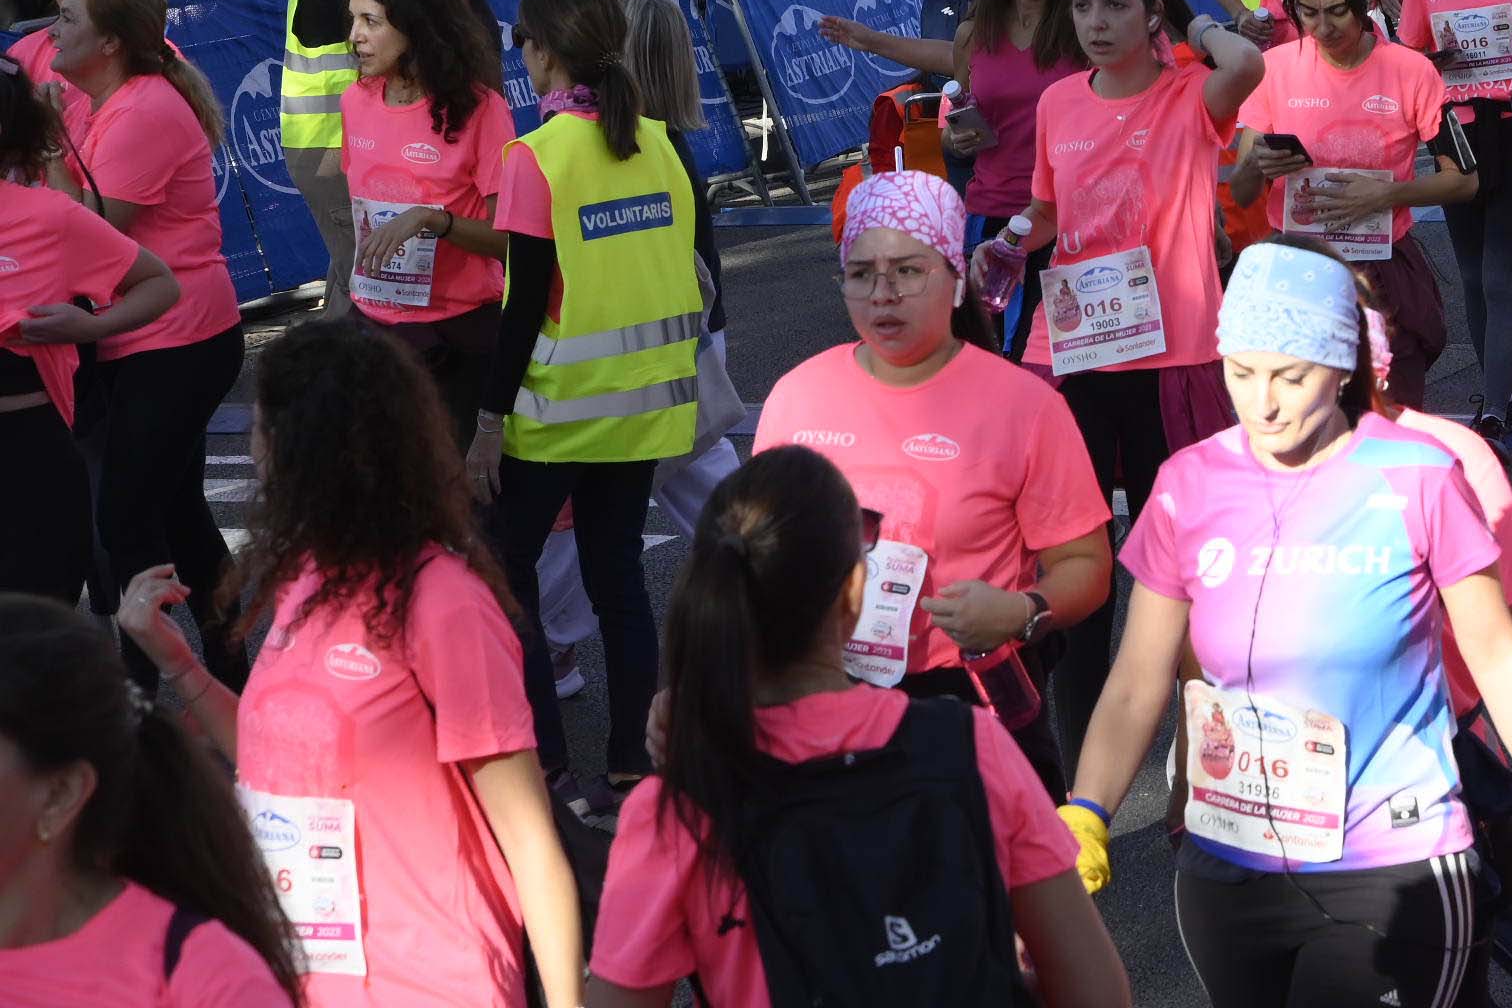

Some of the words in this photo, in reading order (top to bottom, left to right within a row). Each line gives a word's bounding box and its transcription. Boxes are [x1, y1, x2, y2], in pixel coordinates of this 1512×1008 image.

[1461, 37, 1488, 50] 016
[1287, 97, 1330, 109] OYSHO
[1053, 139, 1095, 154] OYSHO
[581, 199, 673, 231] VOLUNTARIS
[1080, 275, 1120, 290] ASTURIANA
[1084, 298, 1123, 318] 016
[1090, 318, 1121, 331] 19003
[1106, 332, 1115, 340] LA
[1125, 339, 1156, 353] Santander
[1062, 351, 1098, 366] OYSHO
[792, 429, 855, 448] OYSHO
[1247, 543, 1393, 577] ZURICH
[847, 642, 869, 652] UJER
[1238, 751, 1289, 779] 016
[1205, 793, 1240, 812] CARRERA
[1240, 803, 1253, 815] DE
[1254, 804, 1266, 816] LA
[309, 822, 342, 833] SUMA
[874, 935, 941, 968] salomon
